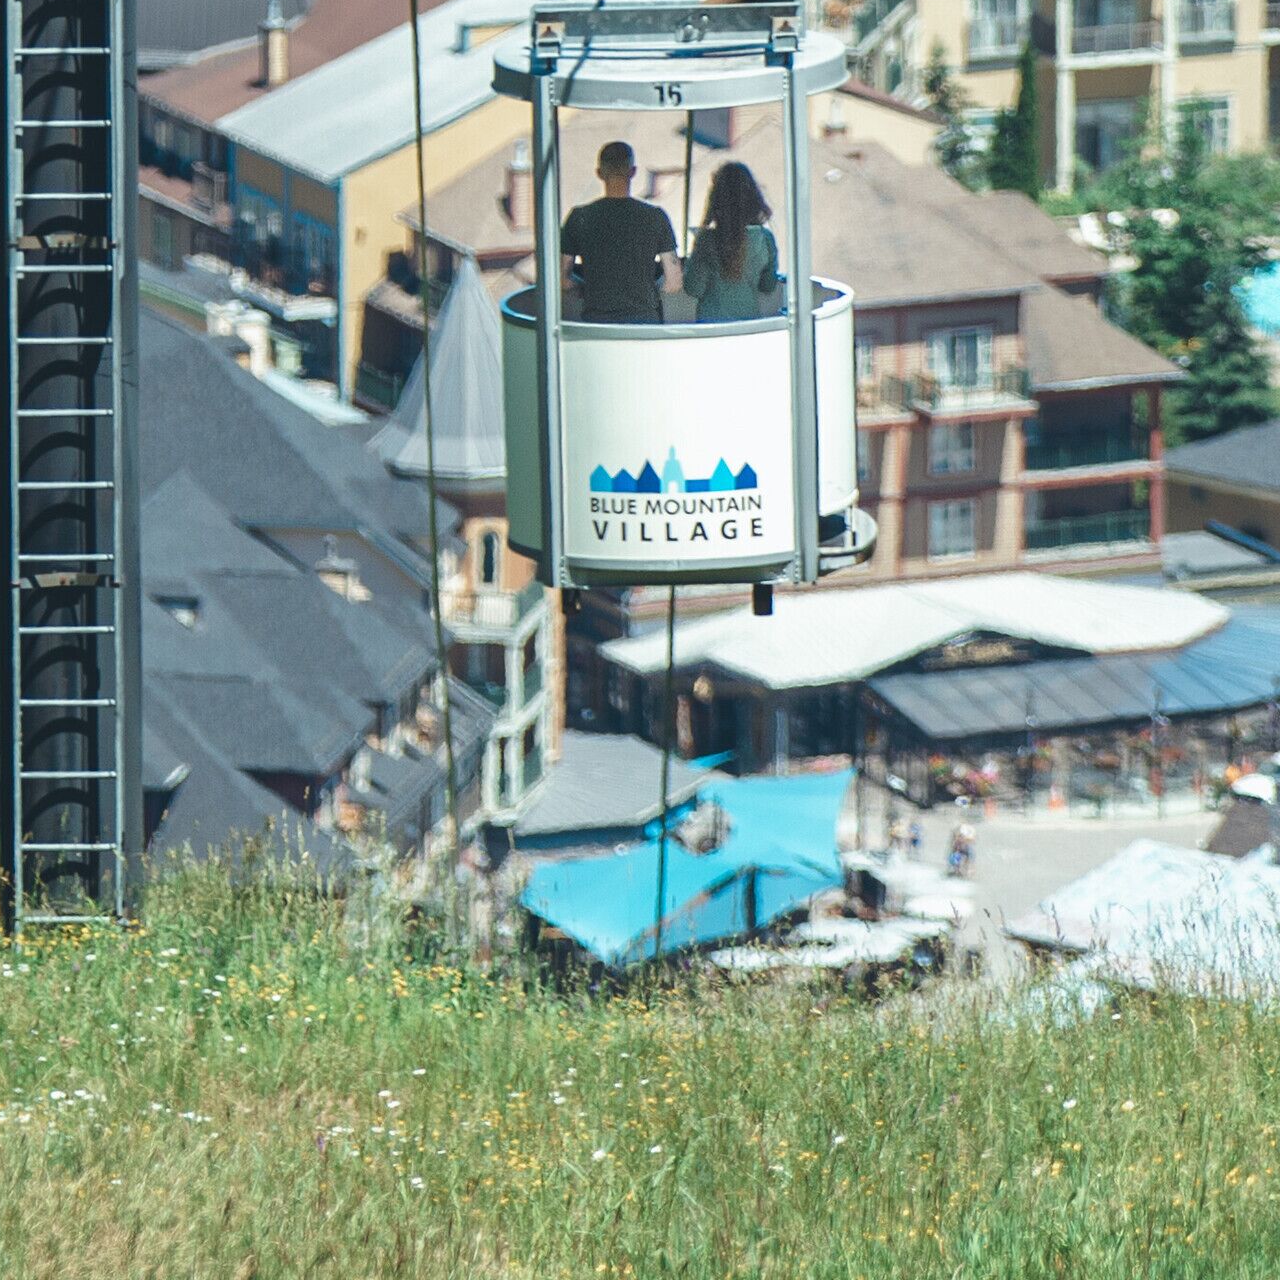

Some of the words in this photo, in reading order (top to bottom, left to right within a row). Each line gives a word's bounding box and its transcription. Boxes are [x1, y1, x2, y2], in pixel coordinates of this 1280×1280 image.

[590, 497, 637, 515] BLUE
[645, 494, 762, 516] MOUNTAIN
[593, 518, 764, 542] VILLAGE
